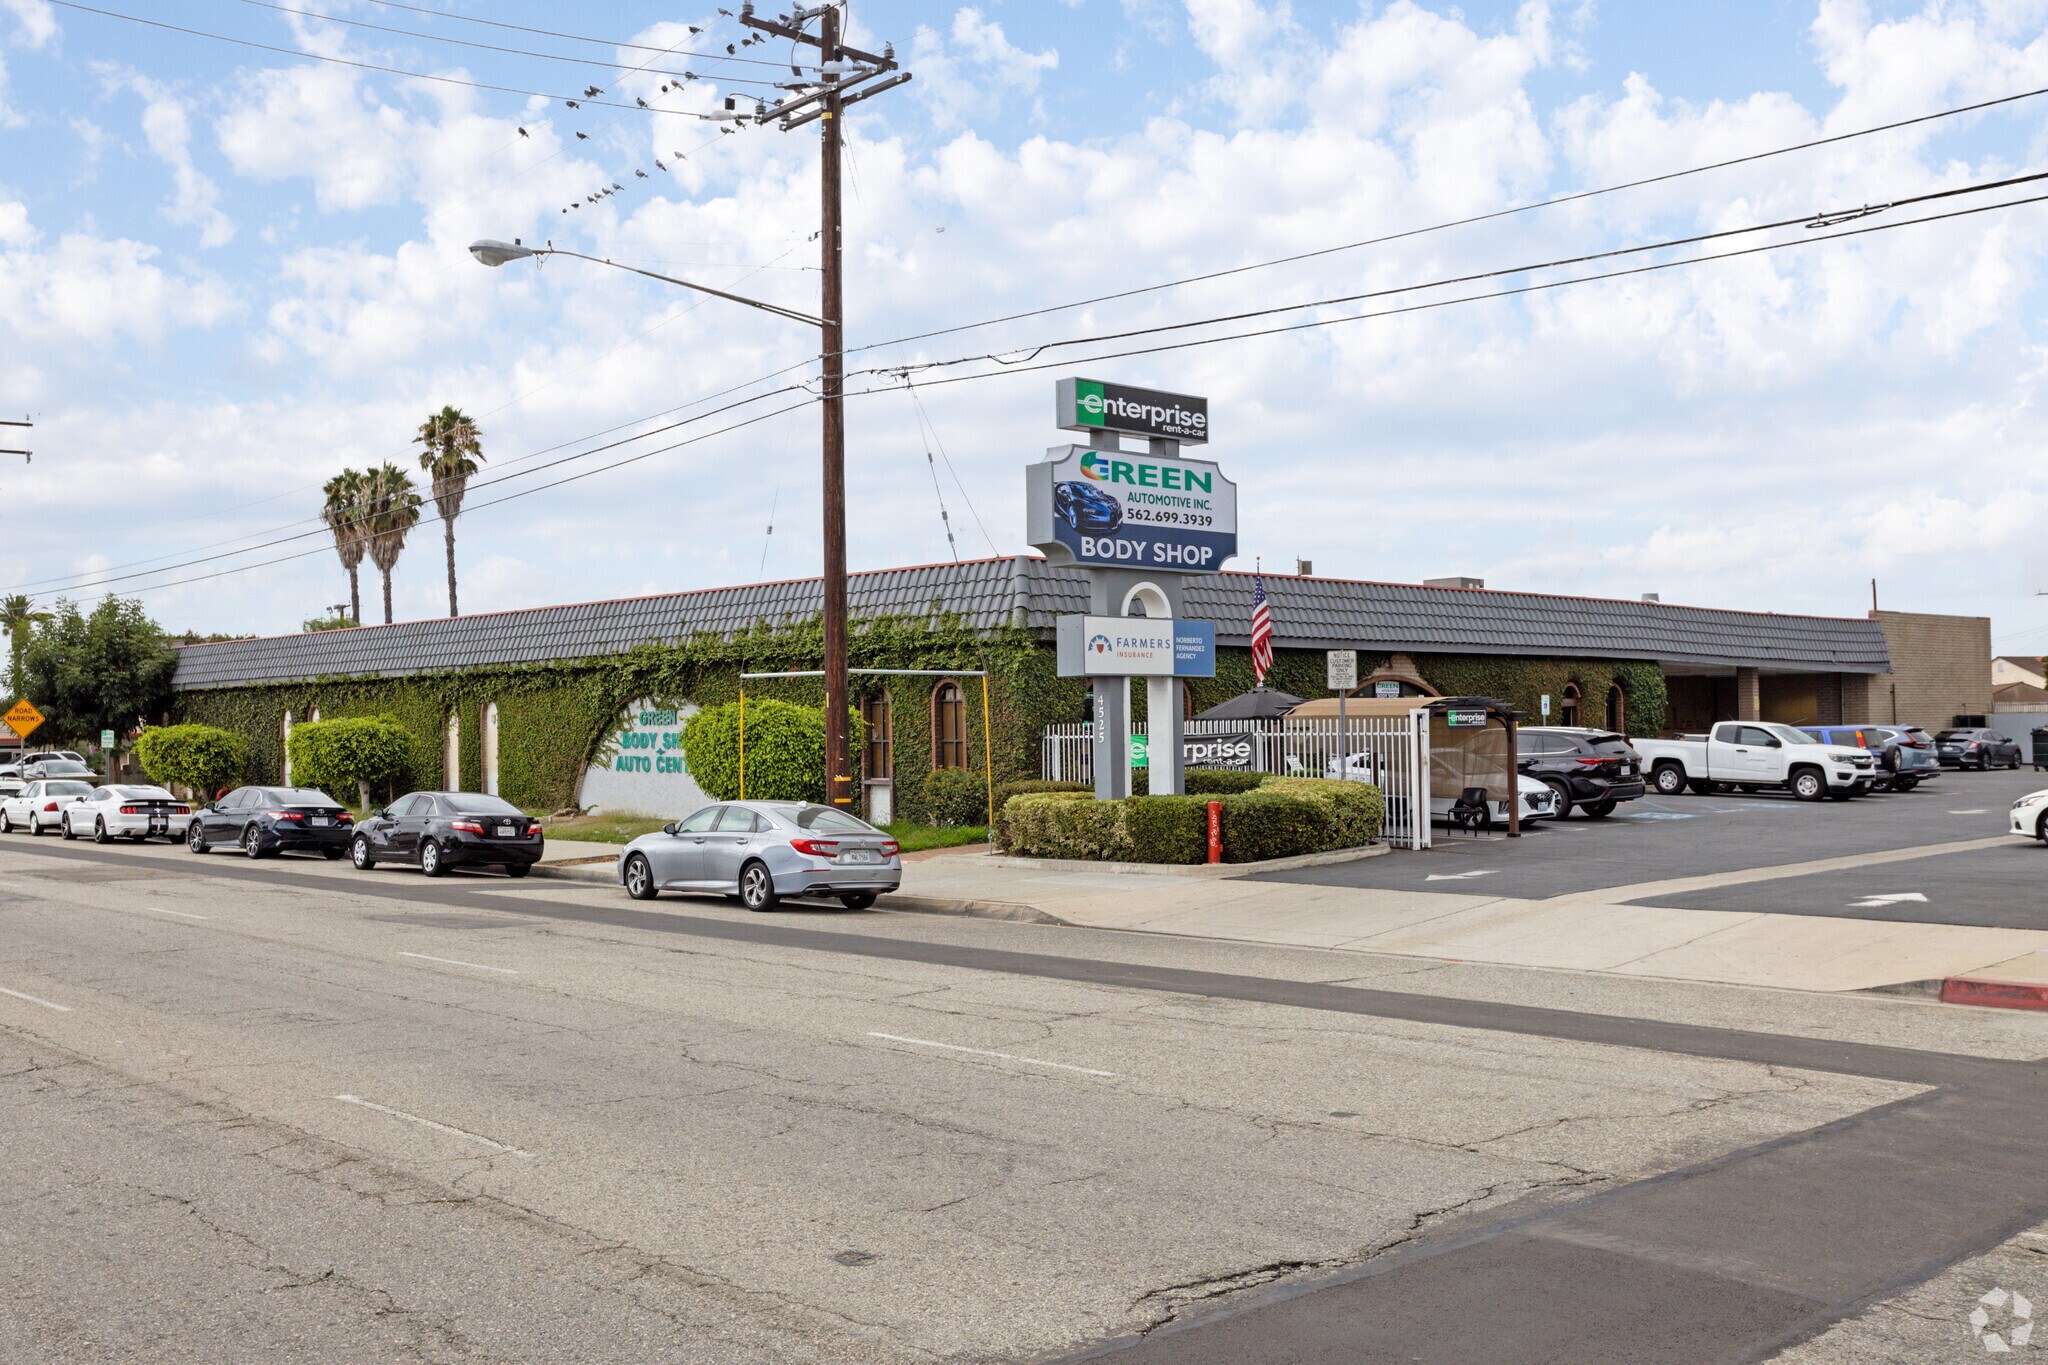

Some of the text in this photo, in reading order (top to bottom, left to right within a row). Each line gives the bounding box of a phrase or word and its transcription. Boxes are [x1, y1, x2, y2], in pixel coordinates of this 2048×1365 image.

[1078, 394, 1206, 428] enterprise
[1163, 424, 1205, 437] rent-a-car
[1080, 451, 1212, 493] GREEN
[1127, 491, 1212, 511] AUTOMOTIVE INC.
[1127, 508, 1212, 527] 562.699.3939
[1081, 536, 1213, 565] BODY SHOP
[1116, 637, 1171, 649] FARMERS
[639, 710, 677, 726] GREEN
[1449, 713, 1485, 723] enterprise
[622, 732, 682, 749] BODY SH
[615, 756, 689, 773] AUTO CENT
[1203, 757, 1249, 765] rent-a-car
